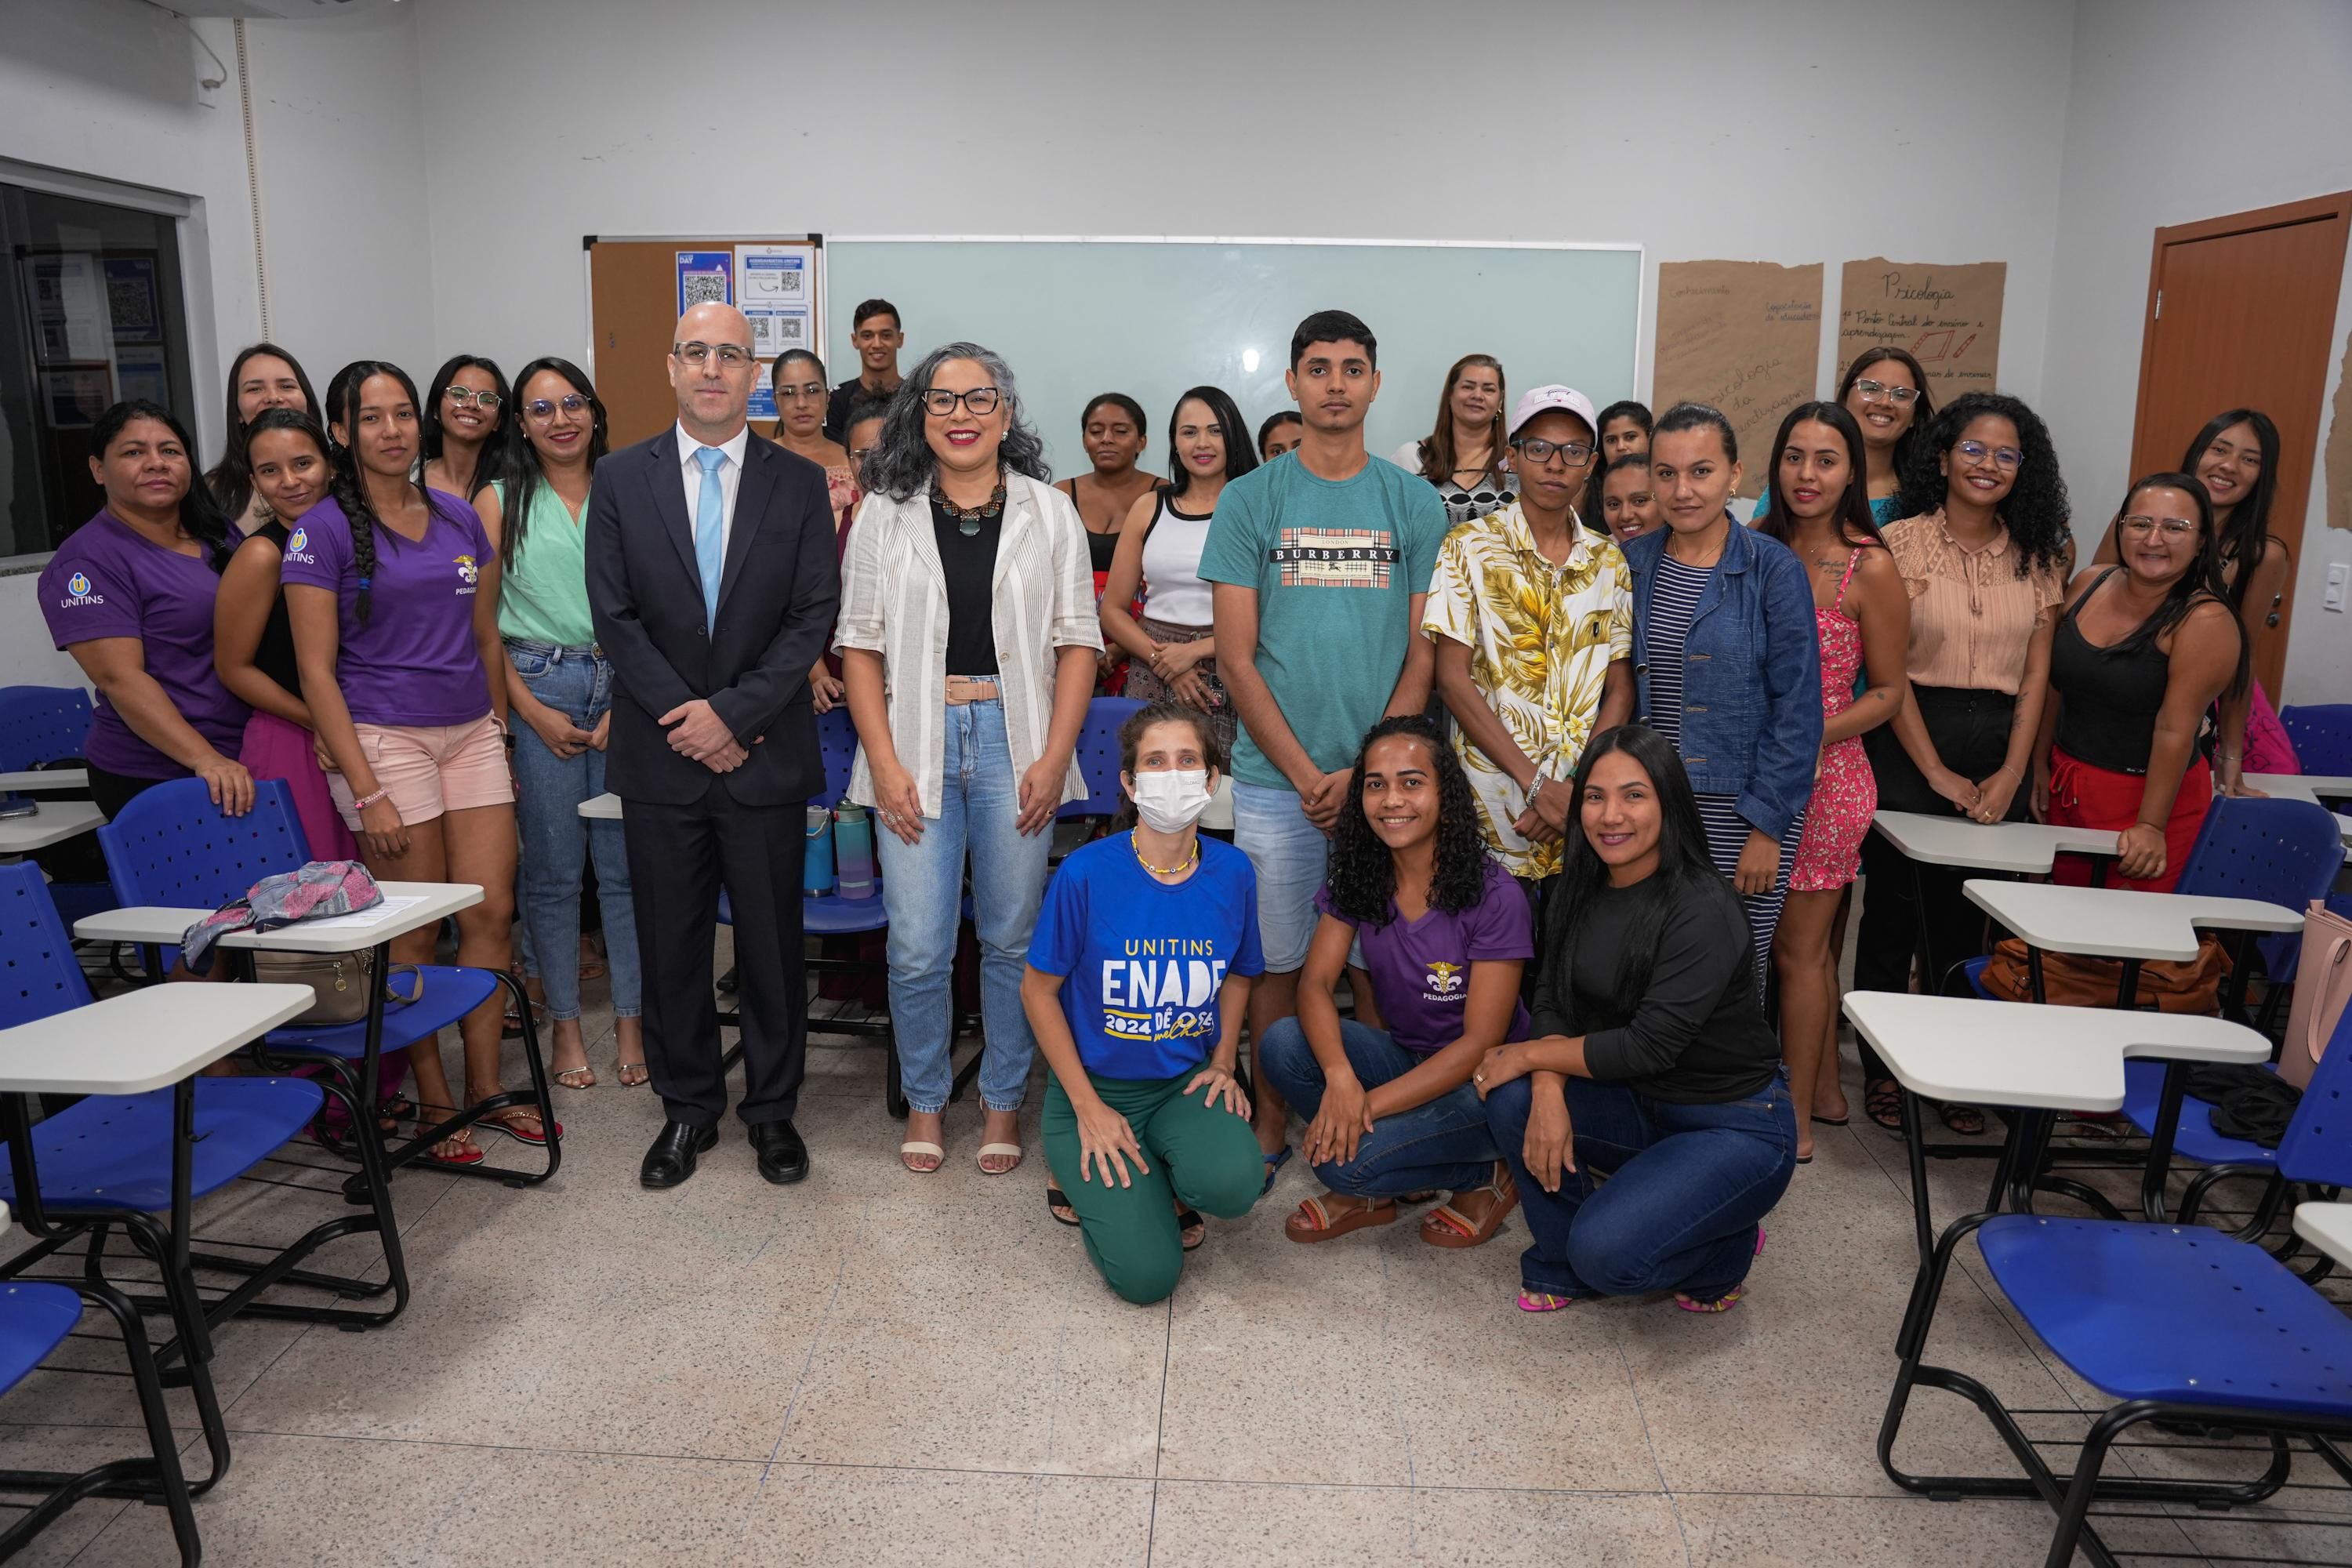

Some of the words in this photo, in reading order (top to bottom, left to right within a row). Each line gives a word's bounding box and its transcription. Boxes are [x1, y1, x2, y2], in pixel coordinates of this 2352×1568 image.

[1882, 271, 1955, 310] Psicologia
[1857, 310, 1883, 325] Ponto
[1888, 314, 1918, 327] Central
[1921, 315, 1936, 327] do
[1937, 319, 1970, 328] ensino
[1732, 394, 1755, 412] da
[1276, 550, 1394, 561] BURBERRY
[61, 595, 104, 608] UNITINS
[1125, 939, 1214, 956] UNITINS
[1102, 960, 1226, 1008] ENADE
[1423, 993, 1468, 1002] PEDAGOGIA
[1106, 1014, 1152, 1034] 2024
[1155, 1006, 1173, 1031] DÊ
[1177, 1011, 1197, 1029] O
